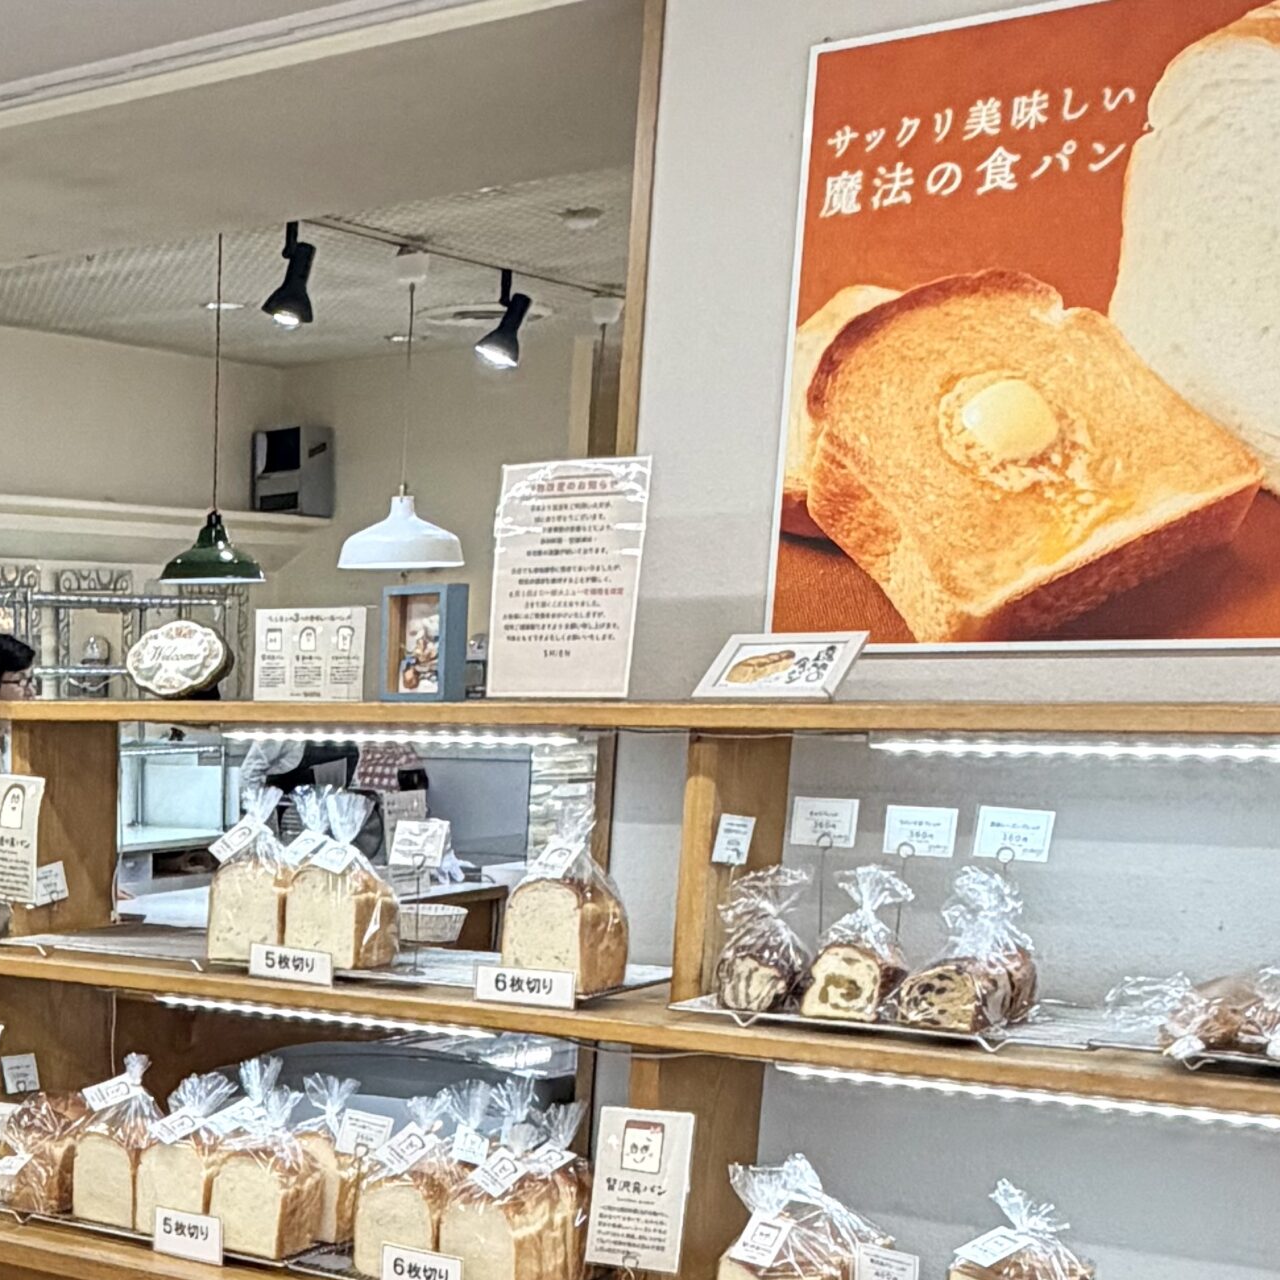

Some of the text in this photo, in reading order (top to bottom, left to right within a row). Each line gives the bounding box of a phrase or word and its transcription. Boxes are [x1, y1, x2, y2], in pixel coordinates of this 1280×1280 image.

[826, 85, 1137, 158] サックリ美味しい
[818, 142, 1127, 220] 魔法の食パン
[151, 645, 201, 662] Welcome
[264, 951, 316, 973] 5枚切り
[494, 972, 555, 995] 6枚切り
[605, 1176, 669, 1197] 贅沢食パン
[161, 1216, 211, 1242] 5枚切り
